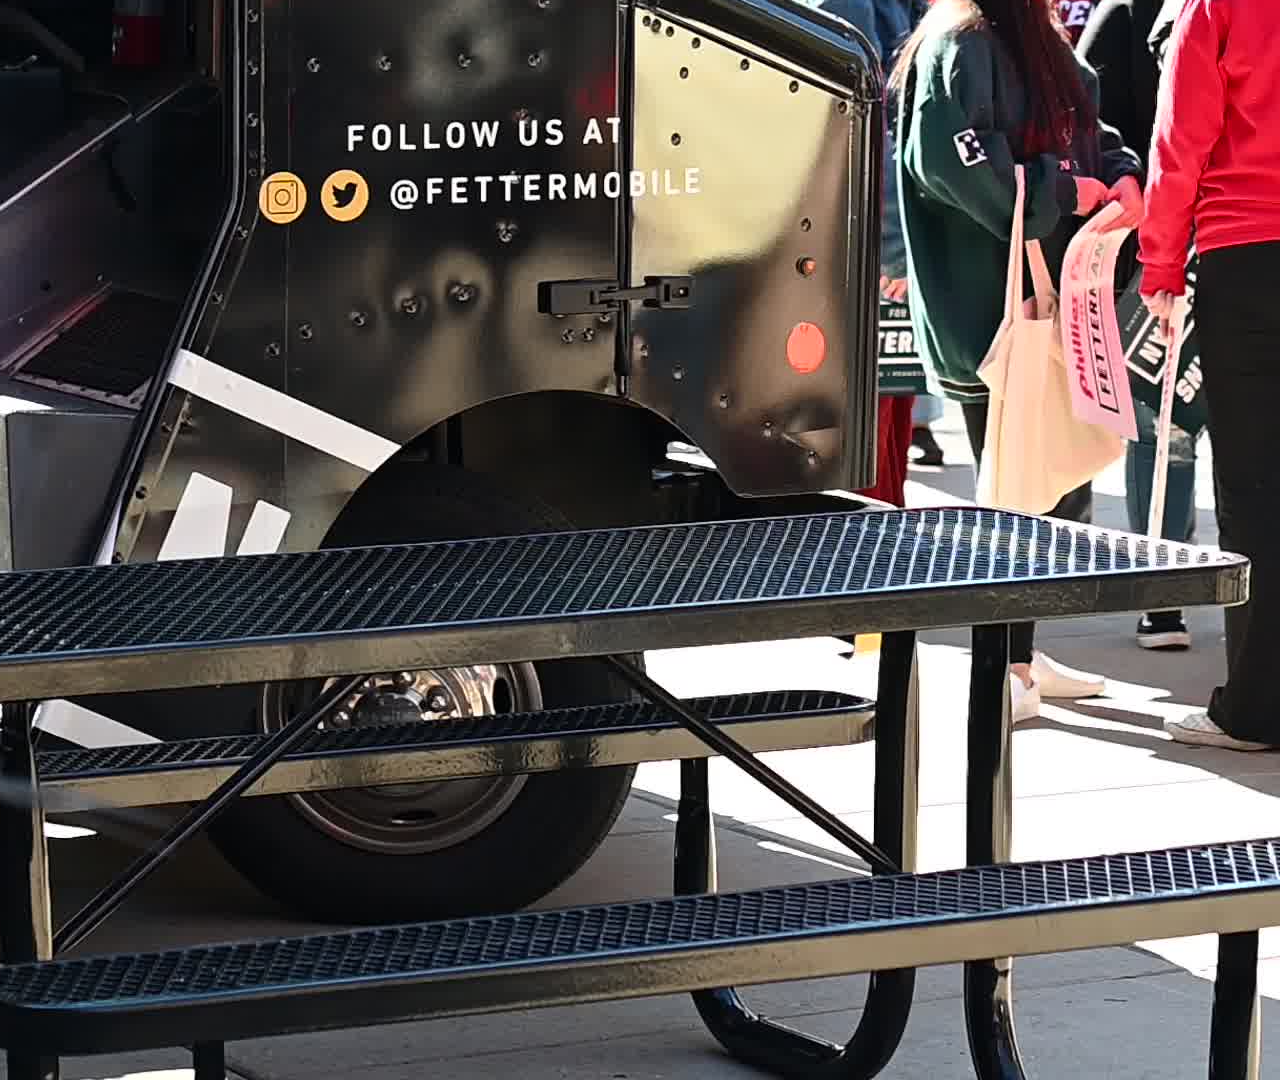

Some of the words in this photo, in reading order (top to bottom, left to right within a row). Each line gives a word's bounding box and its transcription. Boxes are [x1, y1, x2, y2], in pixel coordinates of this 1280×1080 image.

[346, 120, 500, 153] FOLLOW
[518, 118, 564, 147] US
[583, 117, 620, 145] AT
[389, 166, 701, 210] @FETTERMOBILE
